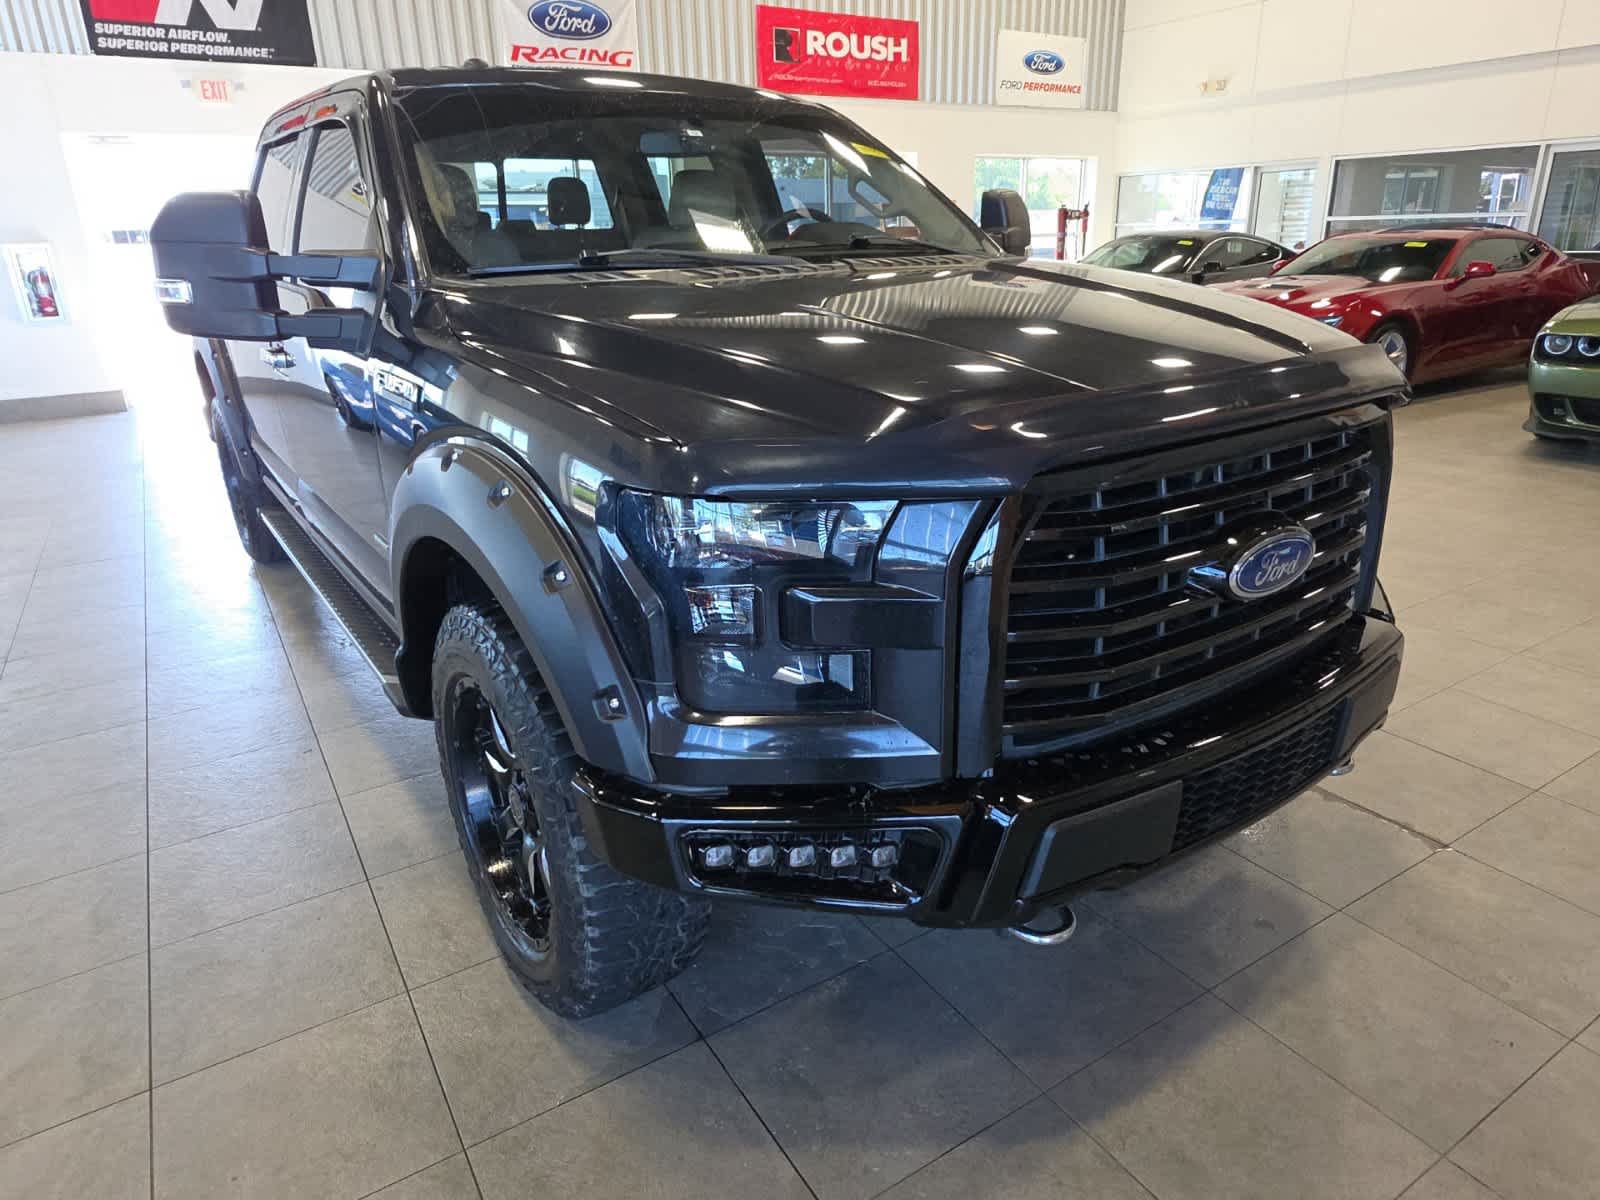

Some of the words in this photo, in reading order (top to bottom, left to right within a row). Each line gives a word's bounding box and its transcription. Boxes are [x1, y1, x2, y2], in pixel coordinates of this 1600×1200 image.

[545, 2, 596, 33] Ford
[94, 23, 167, 40] SUPERIOR
[168, 29, 231, 43] AIRFLOW.
[97, 37, 169, 53] SUPERIOR
[510, 44, 633, 67] RACING
[806, 29, 908, 62] ROUSH
[1031, 53, 1057, 71] Ford
[200, 80, 228, 101] EXIT
[1000, 80, 1022, 90] FORD
[1023, 81, 1082, 94] PERFORMANCE
[1255, 547, 1302, 586] Ford
